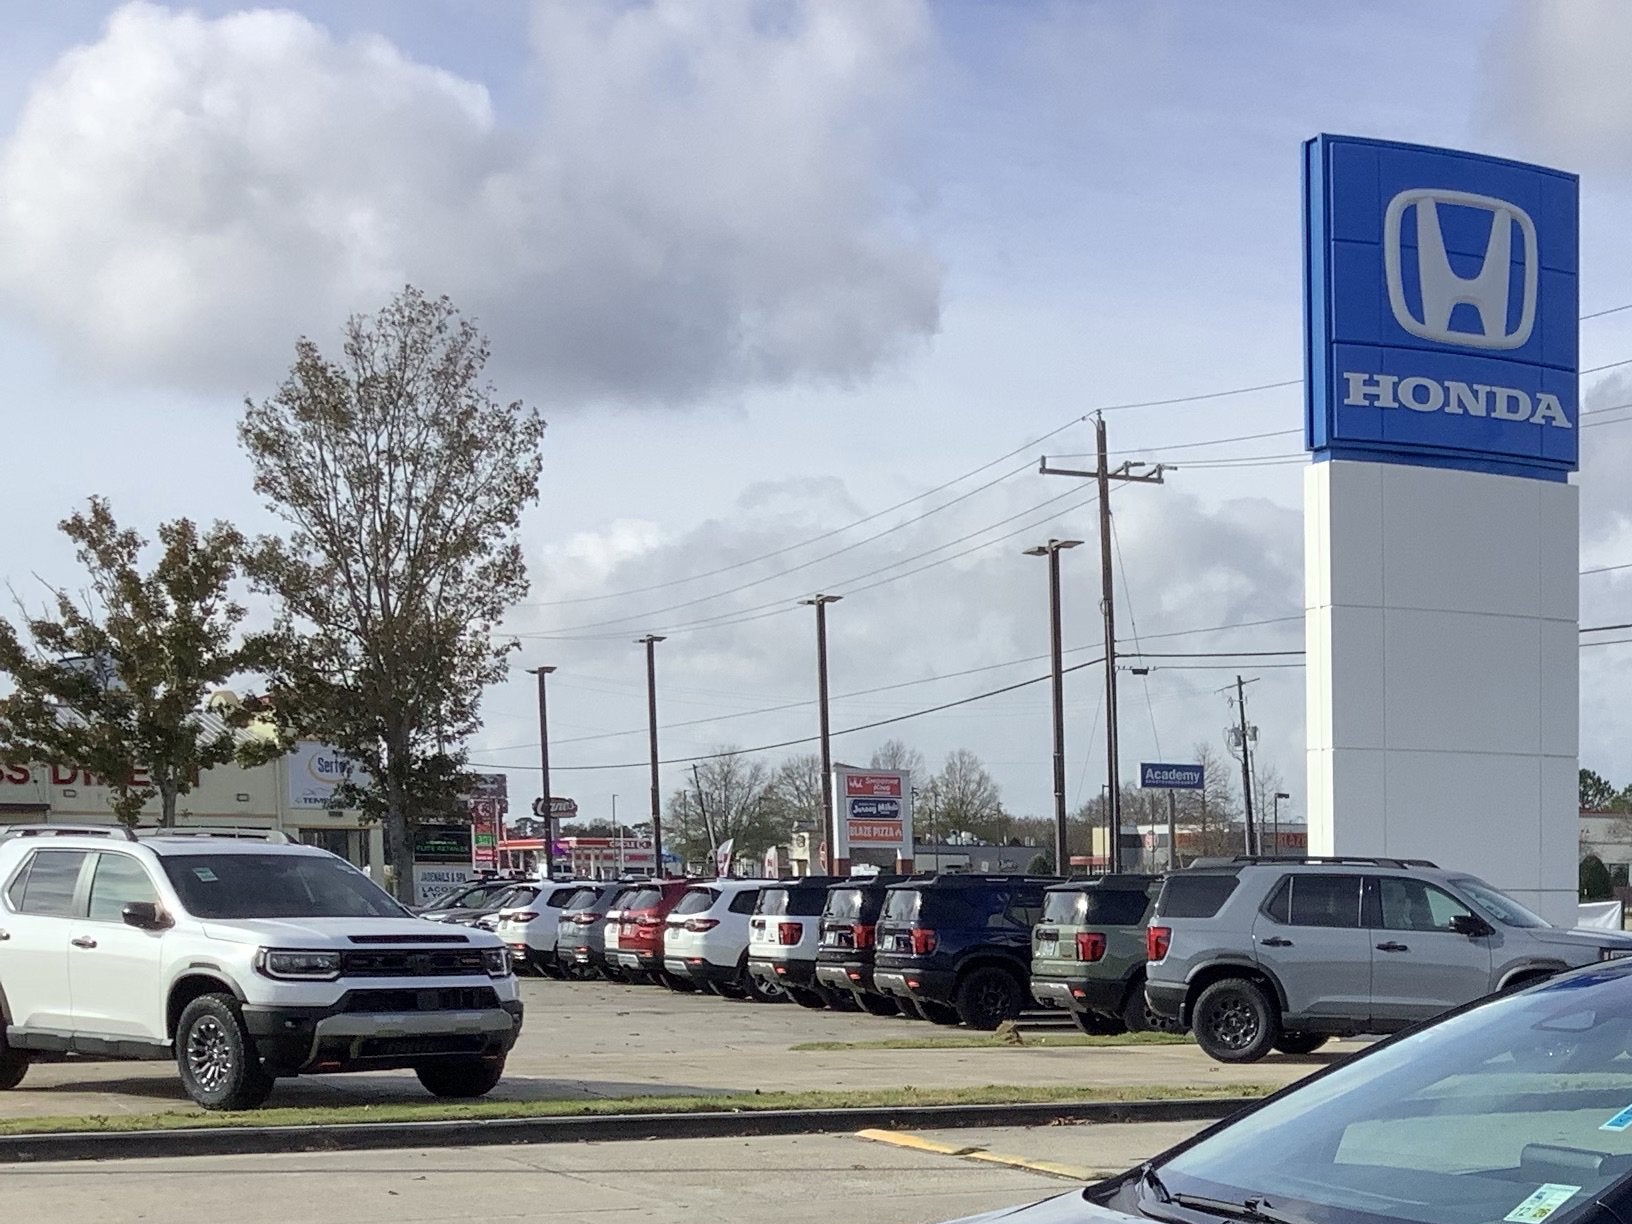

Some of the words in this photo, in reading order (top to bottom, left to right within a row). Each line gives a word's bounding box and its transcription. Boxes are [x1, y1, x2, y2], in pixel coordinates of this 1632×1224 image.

[1343, 371, 1572, 429] HONDA
[1145, 768, 1200, 784] Academy
[849, 825, 872, 837] BLAZE
[873, 826, 894, 837] PIZZA
